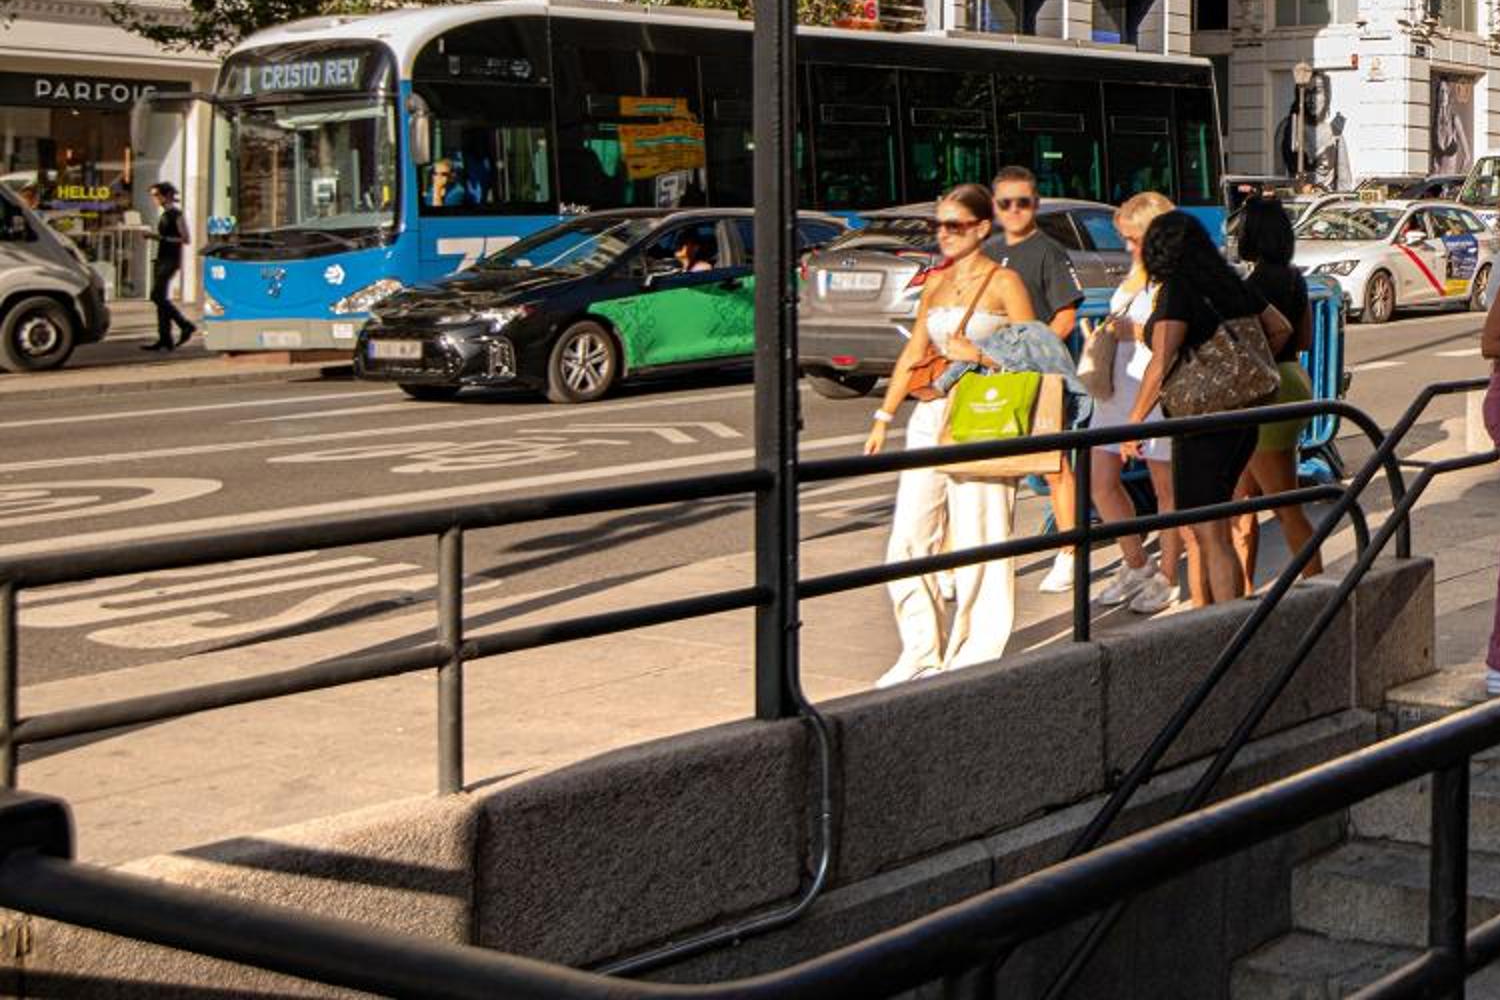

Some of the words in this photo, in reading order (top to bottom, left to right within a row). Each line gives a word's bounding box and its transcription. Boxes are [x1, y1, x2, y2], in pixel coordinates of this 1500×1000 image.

[243, 65, 253, 95] 1
[261, 61, 321, 90] CRISTO
[324, 57, 359, 85] REY
[57, 185, 111, 199] HELLO
